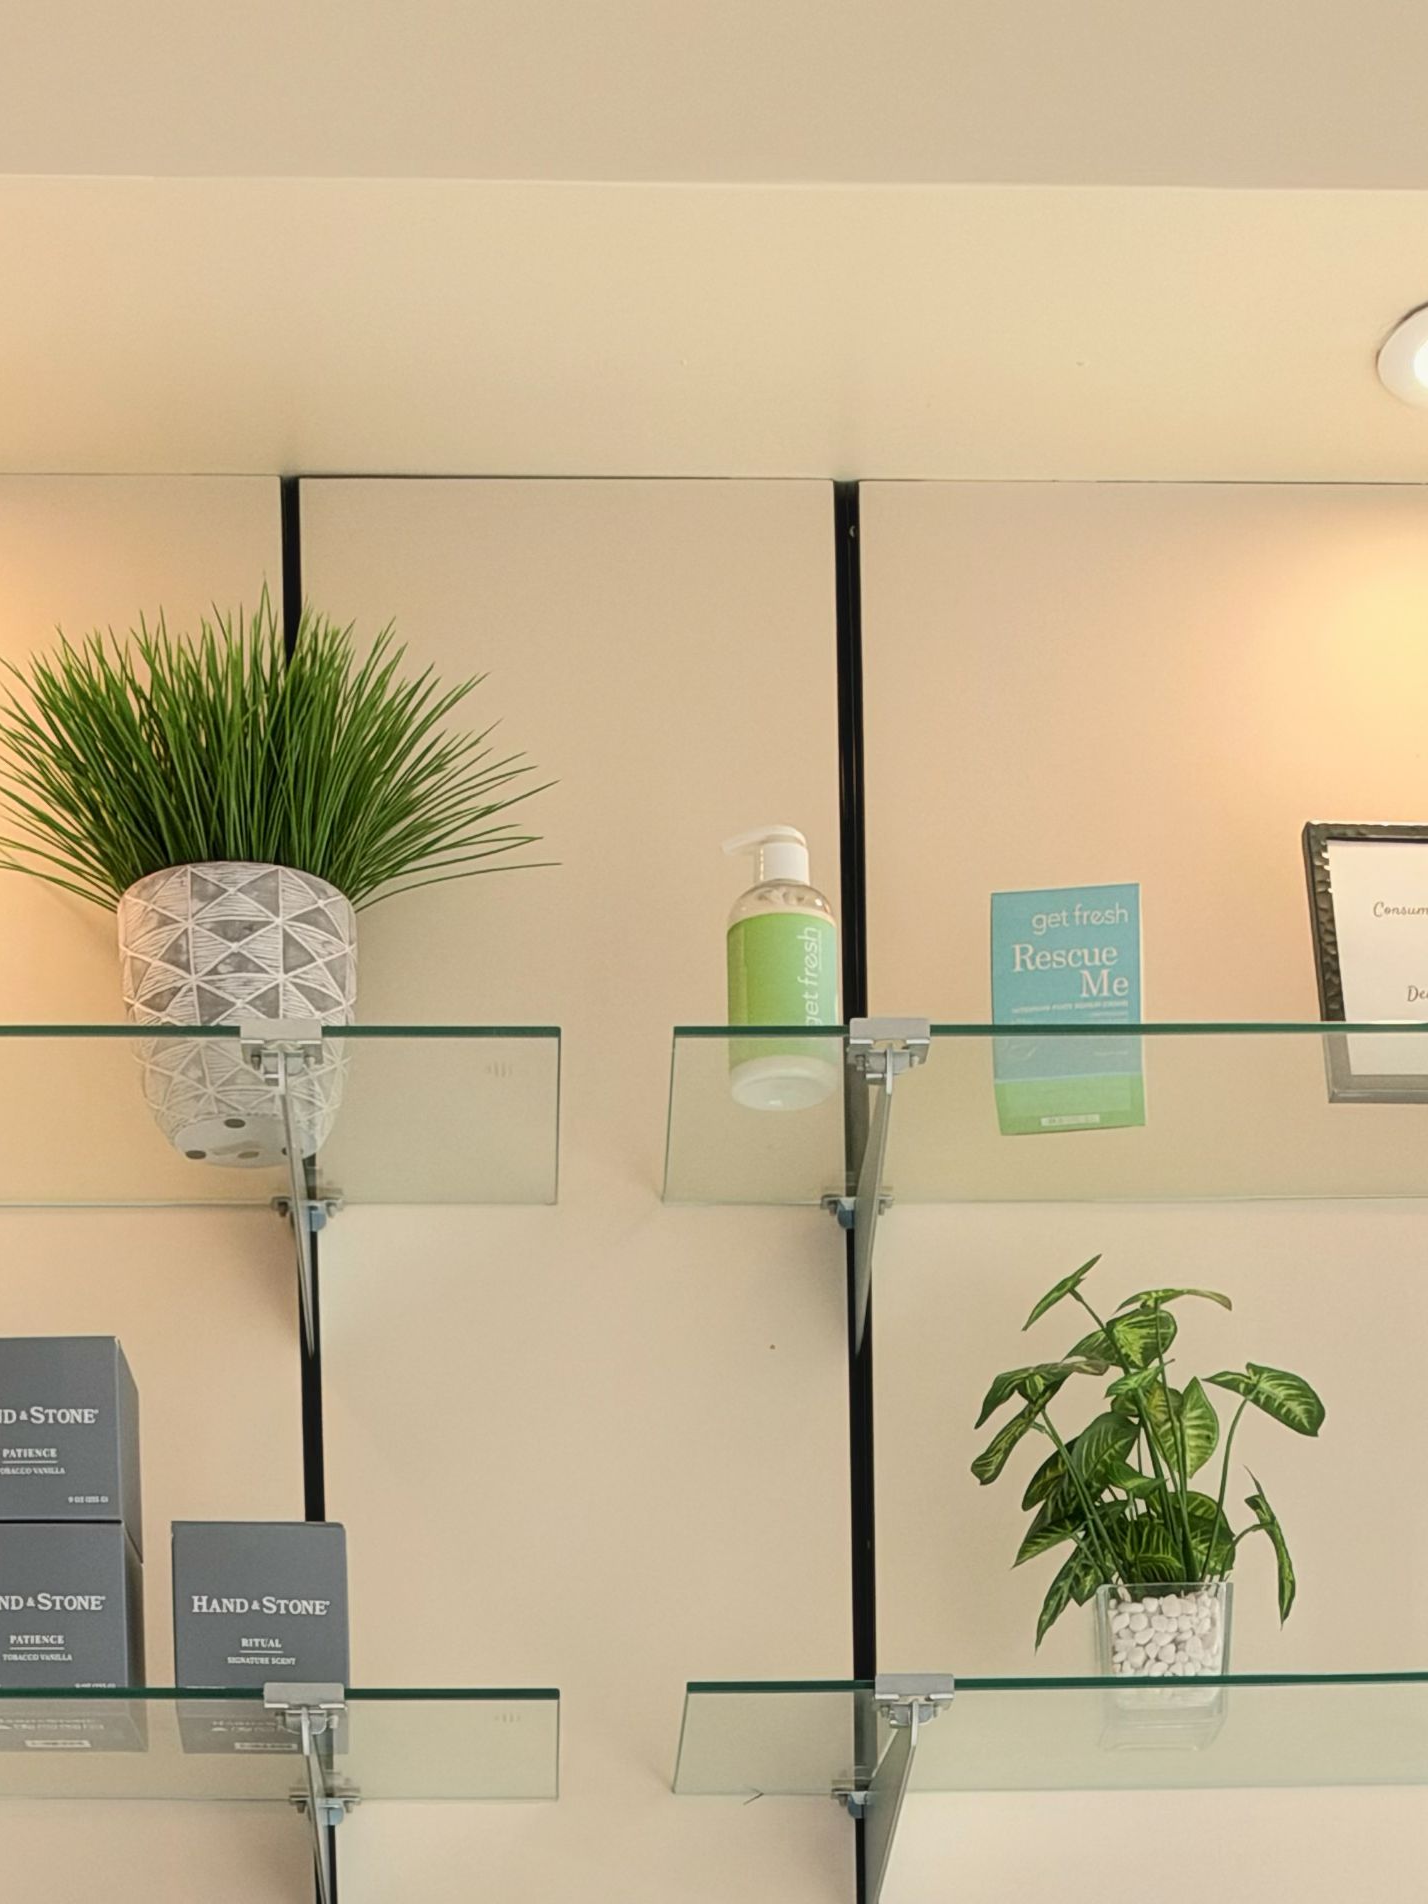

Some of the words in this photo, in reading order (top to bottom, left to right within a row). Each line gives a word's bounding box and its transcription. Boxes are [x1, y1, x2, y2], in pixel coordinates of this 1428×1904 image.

[1032, 912, 1069, 935] get
[1075, 902, 1128, 925] fresh
[797, 927, 819, 985] fresh
[1013, 943, 1117, 972] Rescue
[1081, 968, 1128, 998] Me
[20, 1411, 28, 1421] &
[30, 1406, 96, 1425] STONE
[2, 1447, 58, 1459] PATIENCE
[192, 1595, 248, 1614] HAND
[252, 1600, 260, 1610] &
[263, 1596, 326, 1616] STONE
[241, 1637, 282, 1649] RITUAL
